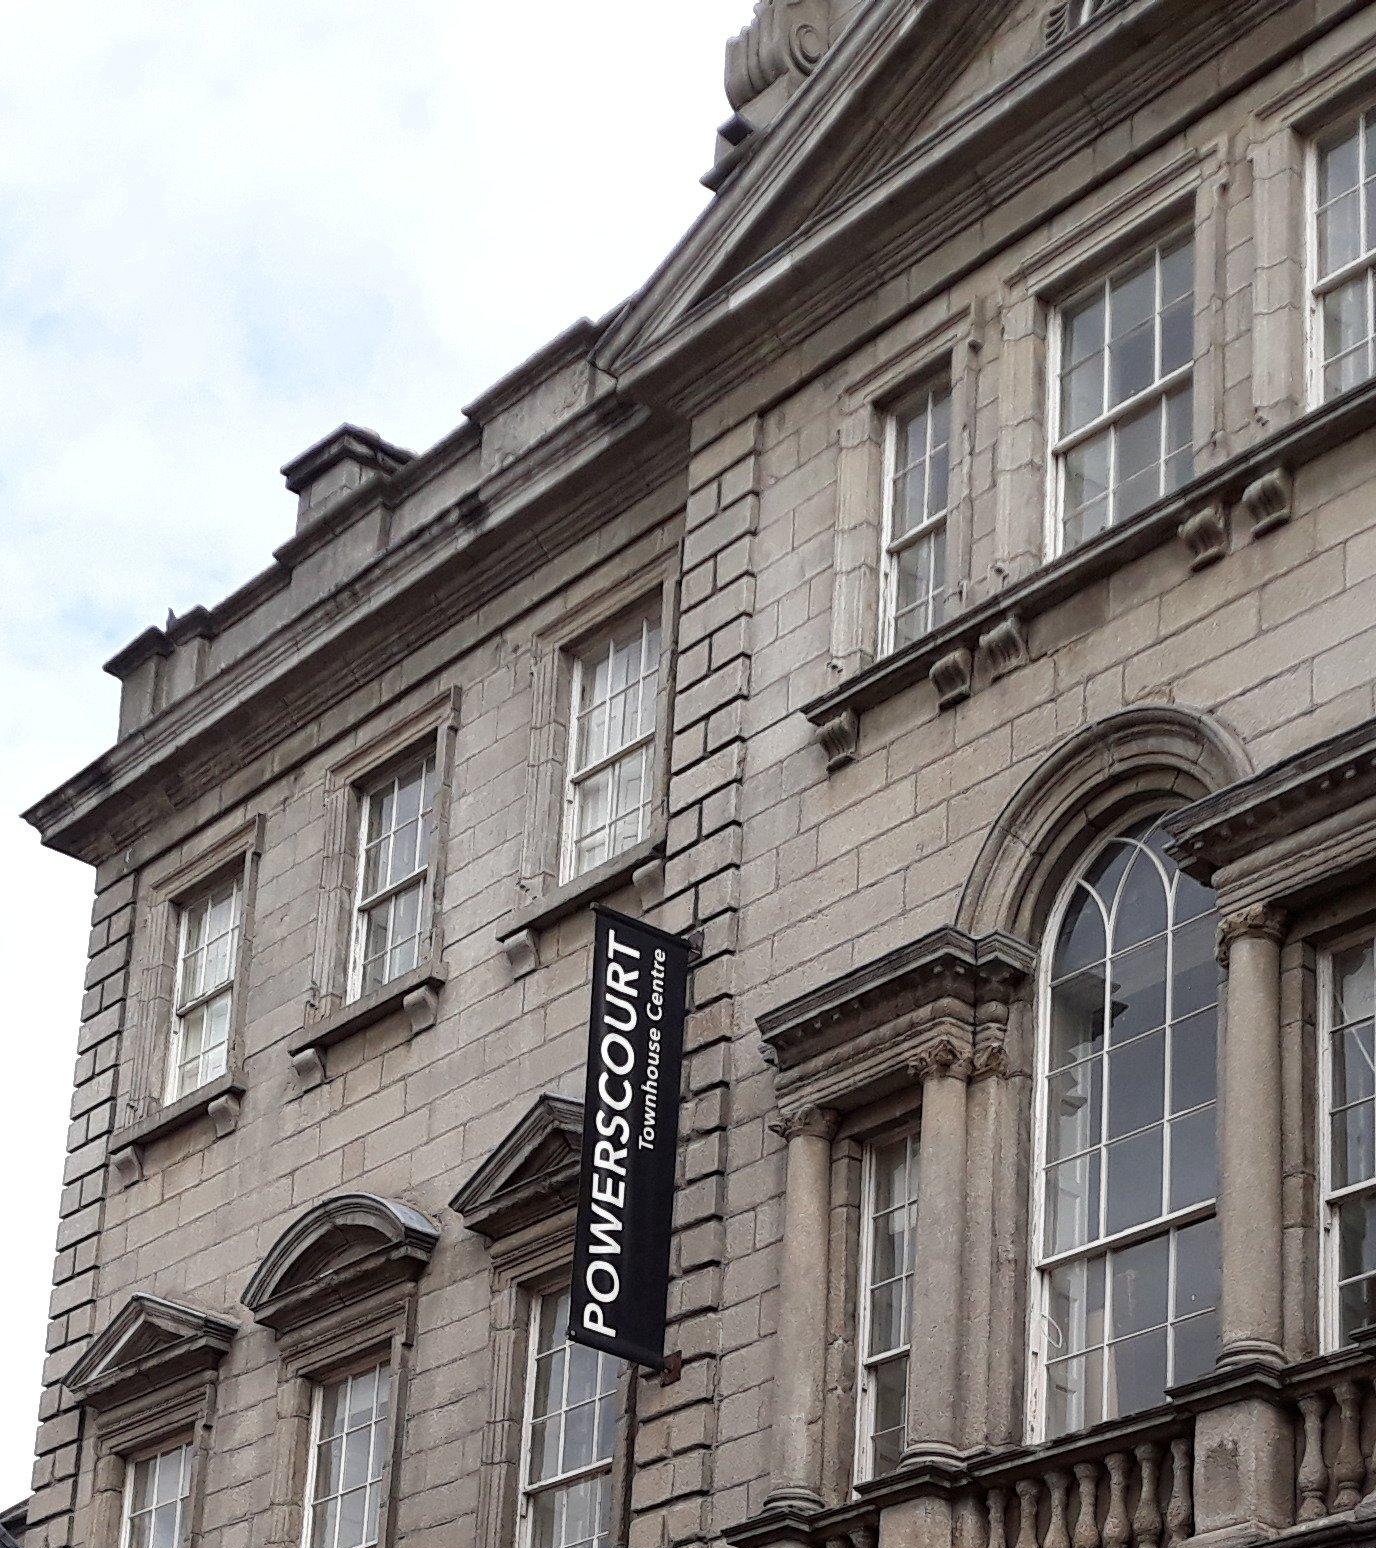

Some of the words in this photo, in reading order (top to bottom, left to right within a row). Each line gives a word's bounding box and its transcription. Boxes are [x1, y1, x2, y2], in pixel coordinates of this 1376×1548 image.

[646, 947, 666, 1021] Centre
[582, 928, 641, 1339] POWERSCOURT
[638, 1027, 661, 1151] Townhouse
